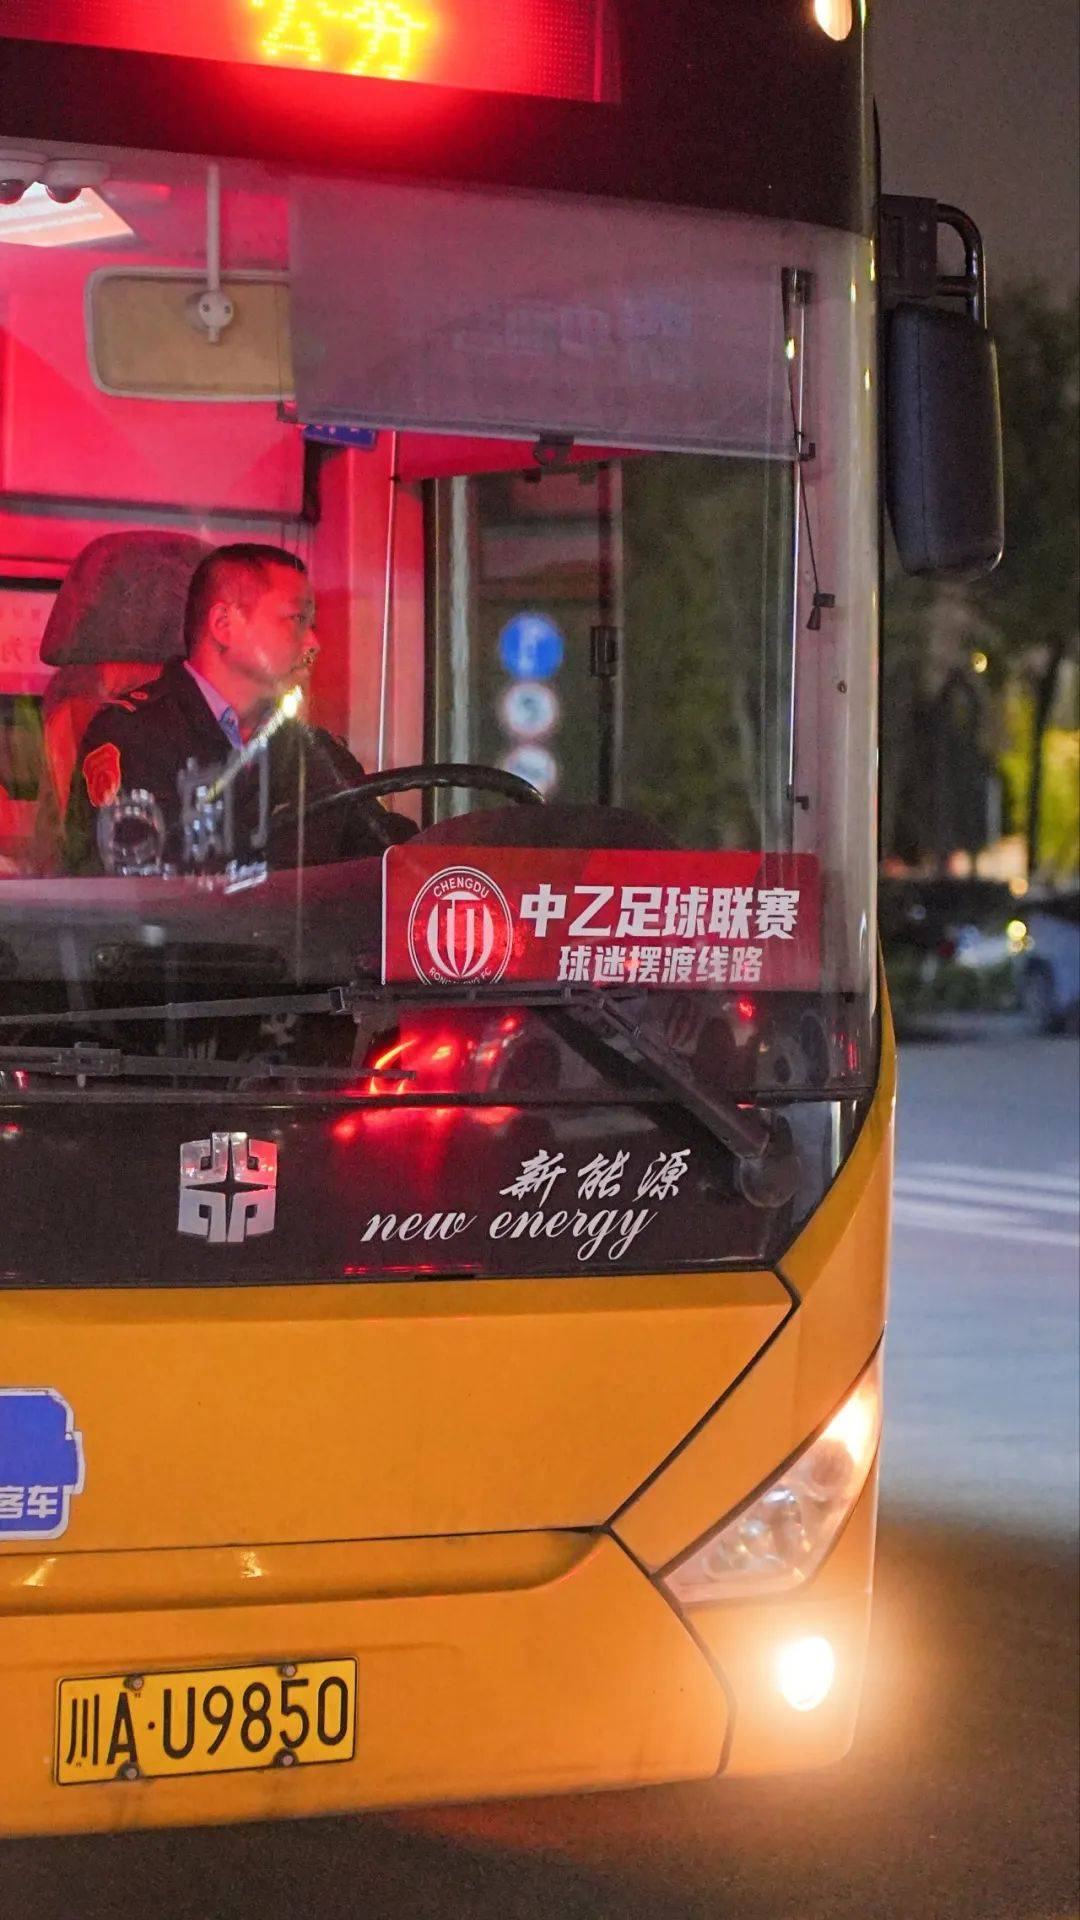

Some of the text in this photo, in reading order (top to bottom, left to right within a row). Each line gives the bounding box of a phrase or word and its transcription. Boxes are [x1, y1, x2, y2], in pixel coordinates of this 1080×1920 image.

[433, 876, 490, 898] CHENGDU
[519, 883, 801, 940] 中乙足球联赛
[557, 945, 763, 984] 球迷摆渡线路
[499, 1149, 691, 1208] 新能源
[360, 1207, 660, 1261] new energy
